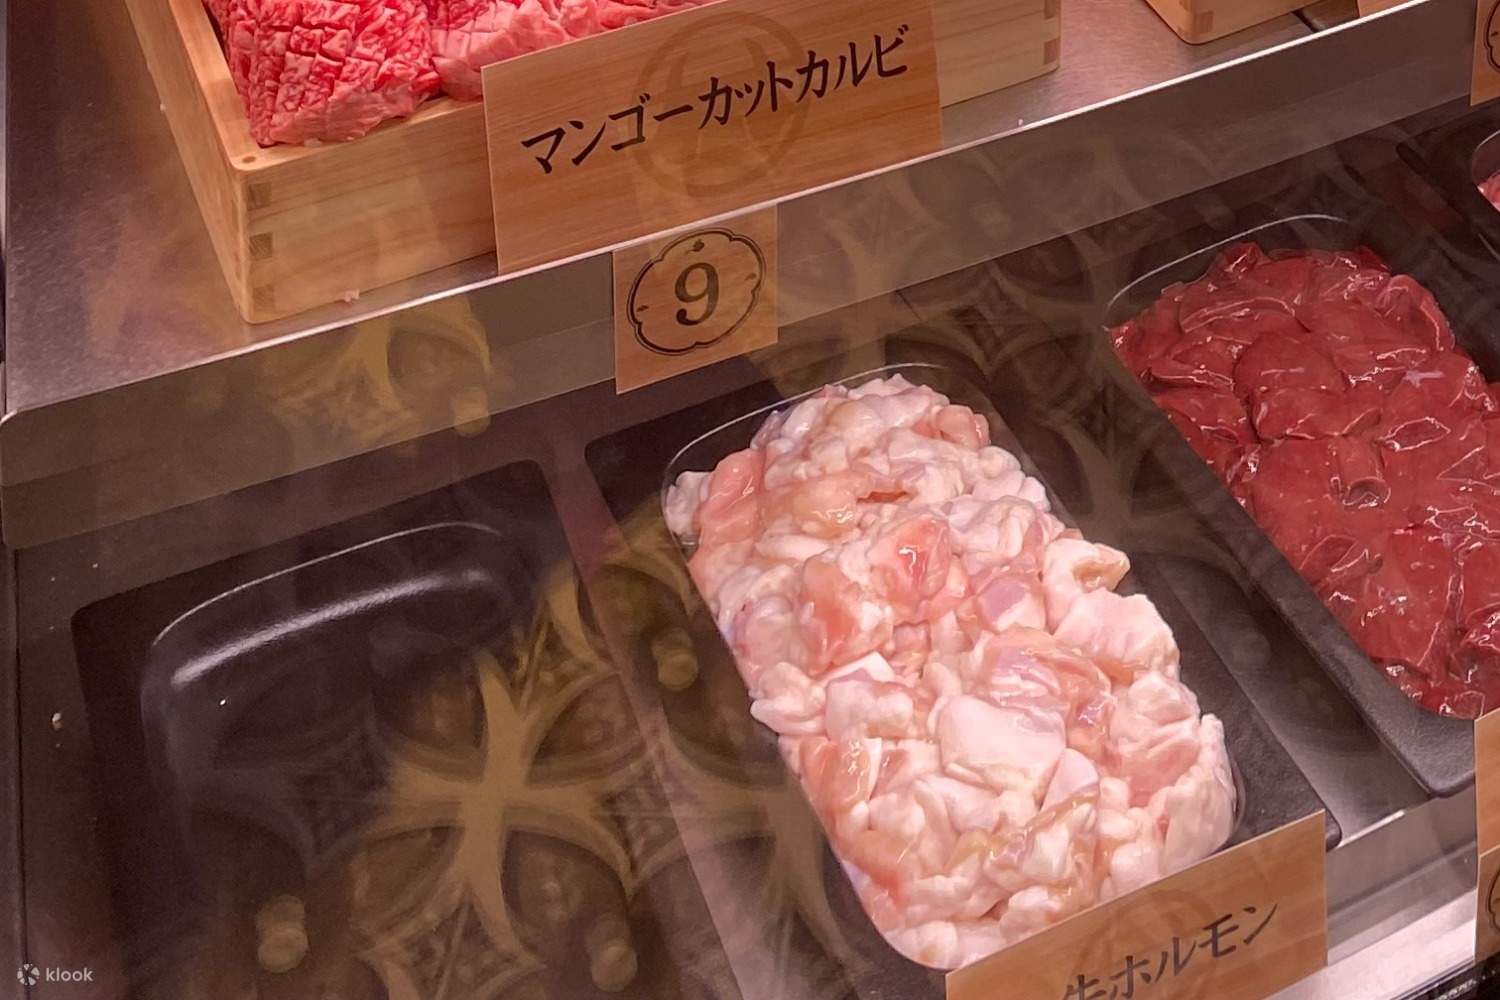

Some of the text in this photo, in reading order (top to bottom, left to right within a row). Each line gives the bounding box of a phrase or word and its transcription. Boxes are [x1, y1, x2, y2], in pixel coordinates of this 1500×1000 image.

[520, 23, 910, 175] マンゴーカットカルビ
[674, 262, 720, 326] 9
